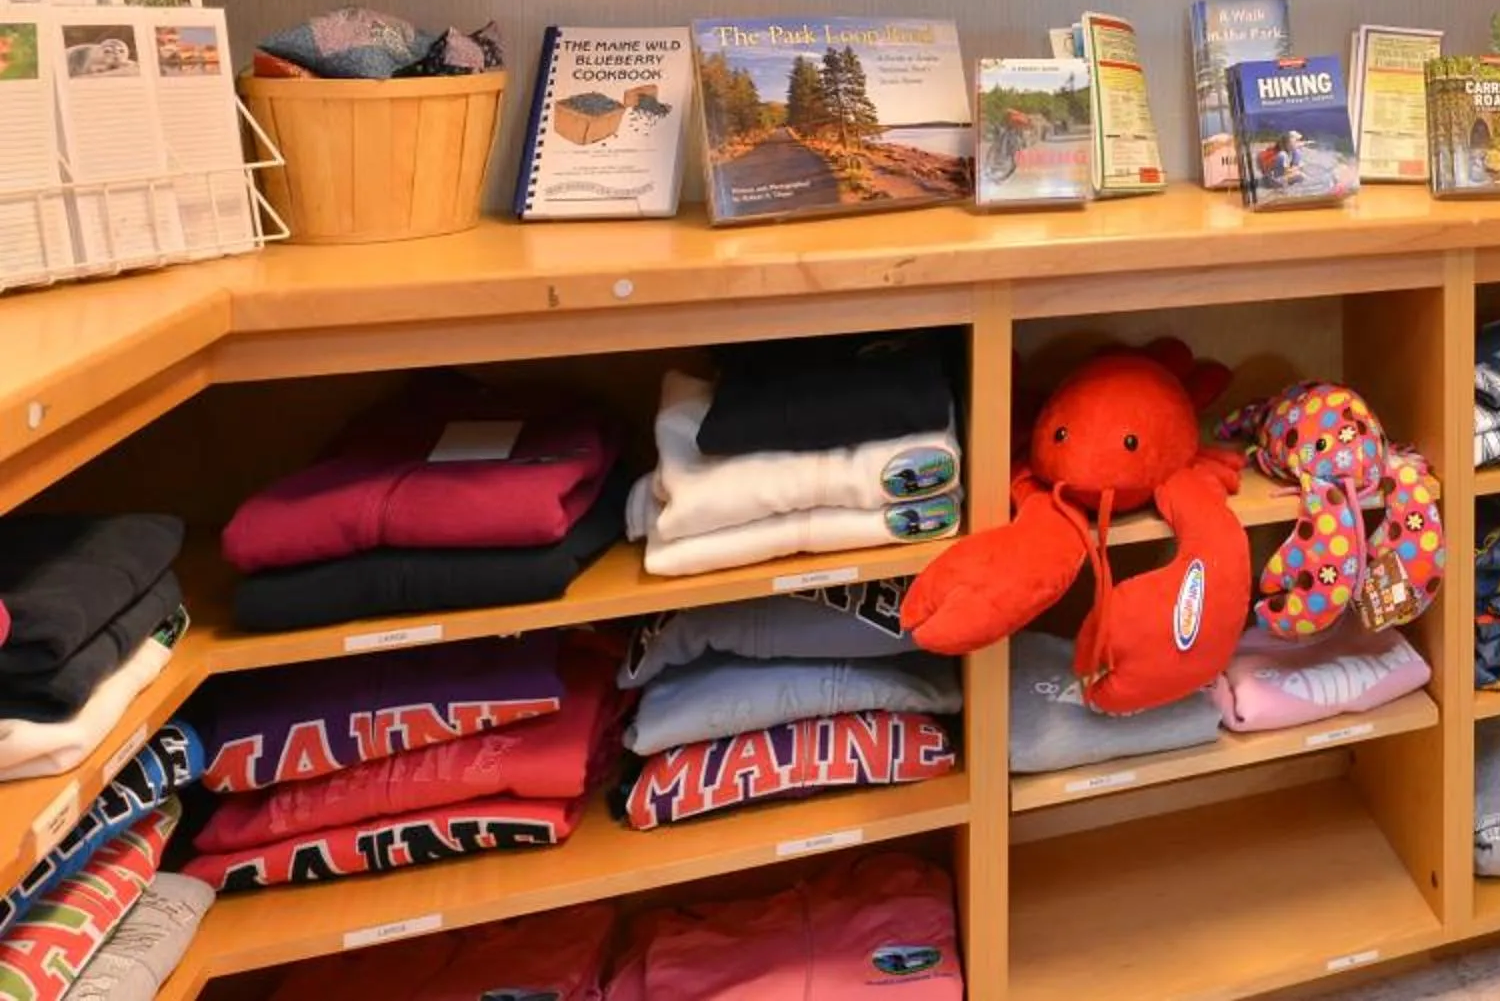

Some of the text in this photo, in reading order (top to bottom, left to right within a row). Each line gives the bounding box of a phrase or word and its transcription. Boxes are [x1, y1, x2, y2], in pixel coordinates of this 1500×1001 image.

[1230, 8, 1265, 23] Walk
[718, 25, 760, 47] The
[768, 24, 817, 45] Park
[824, 24, 880, 50] Loop
[1224, 29, 1247, 42] the
[1250, 27, 1282, 41] Park
[563, 39, 681, 52] THE MAINE WILD
[575, 54, 665, 66] BLUEBERRY
[572, 68, 663, 82] COOKBOOK
[1257, 72, 1333, 99] HIKING
[626, 709, 956, 832] MAINE
